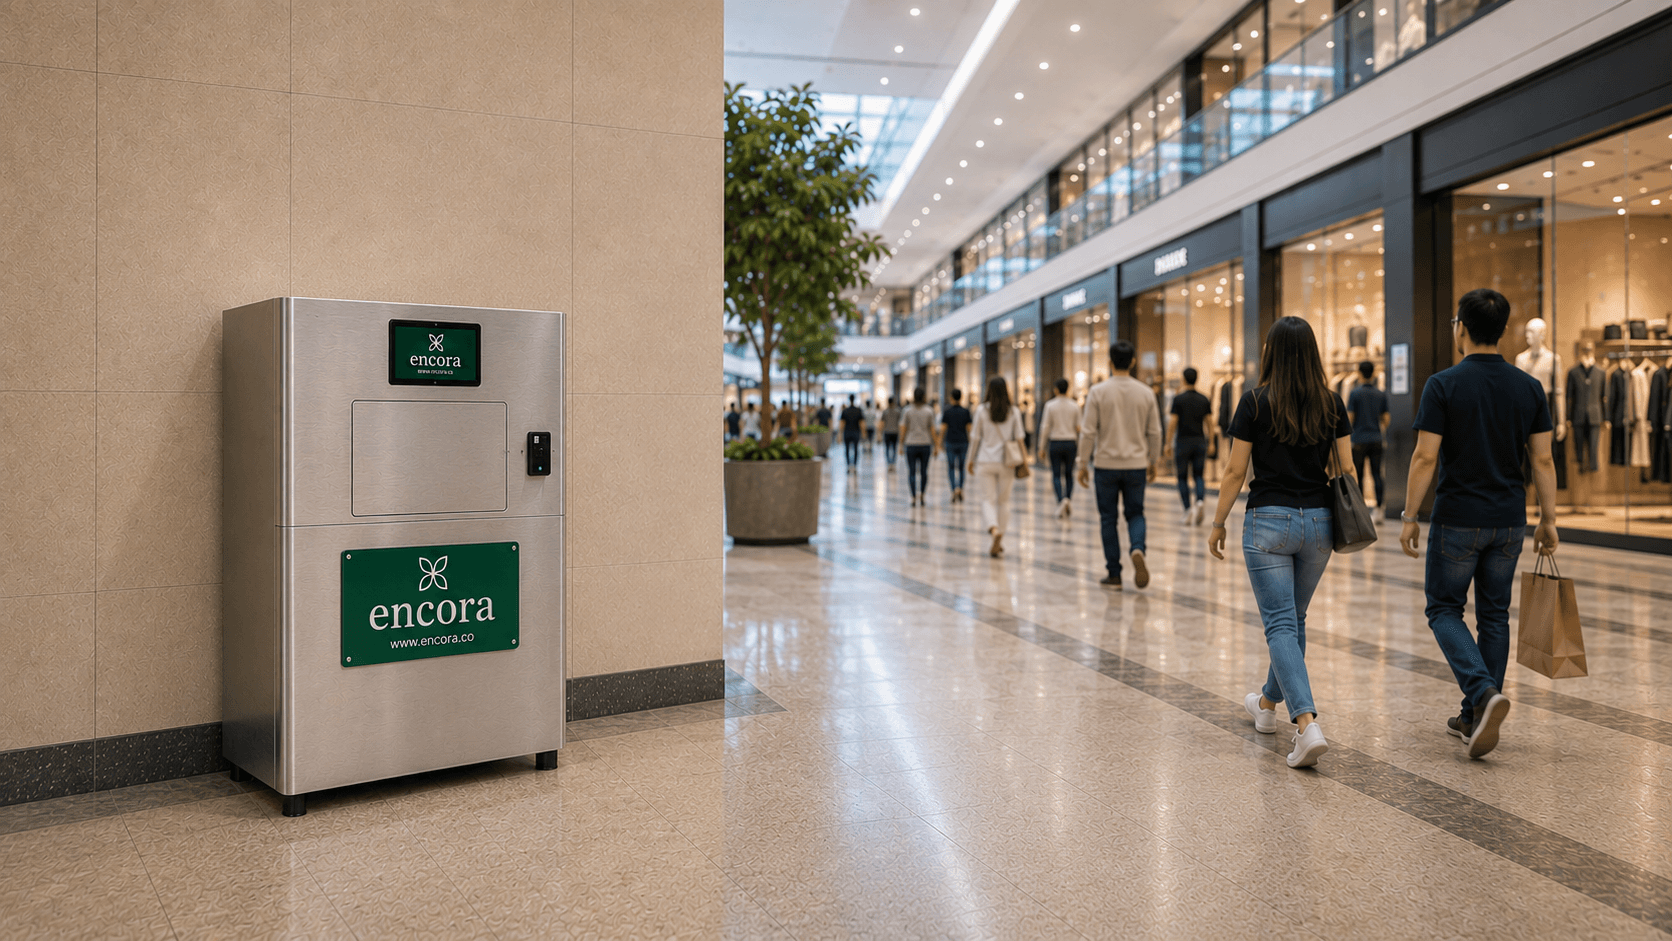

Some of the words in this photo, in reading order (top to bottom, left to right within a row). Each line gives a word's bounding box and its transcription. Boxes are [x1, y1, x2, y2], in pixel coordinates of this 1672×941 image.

[410, 355, 461, 367] encora
[369, 596, 495, 631] encora
[390, 633, 474, 649] www.encora.co
